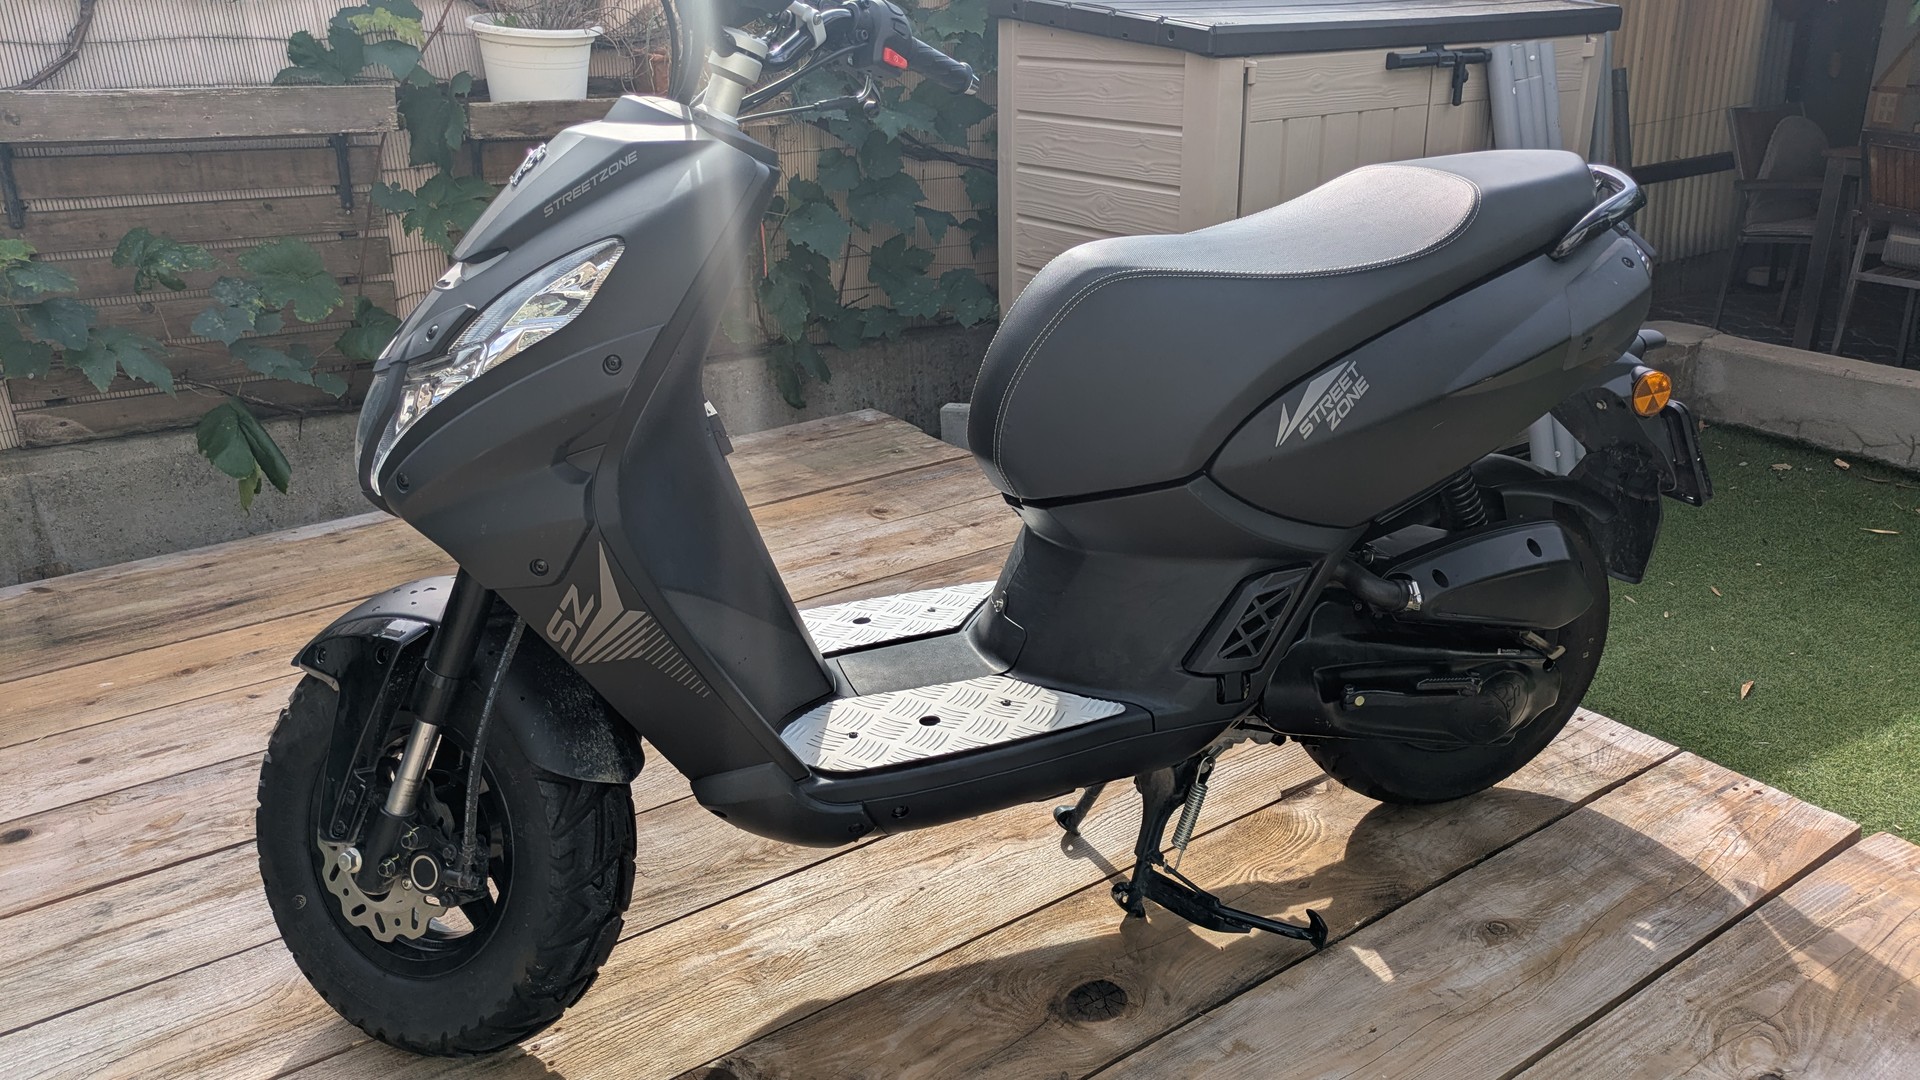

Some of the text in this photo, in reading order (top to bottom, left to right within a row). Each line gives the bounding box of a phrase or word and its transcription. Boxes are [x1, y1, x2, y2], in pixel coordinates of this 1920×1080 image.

[543, 150, 638, 218] STREETZONE
[1299, 360, 1358, 440] STREET
[1326, 375, 1370, 432] ZONE
[546, 583, 595, 653] SZ
